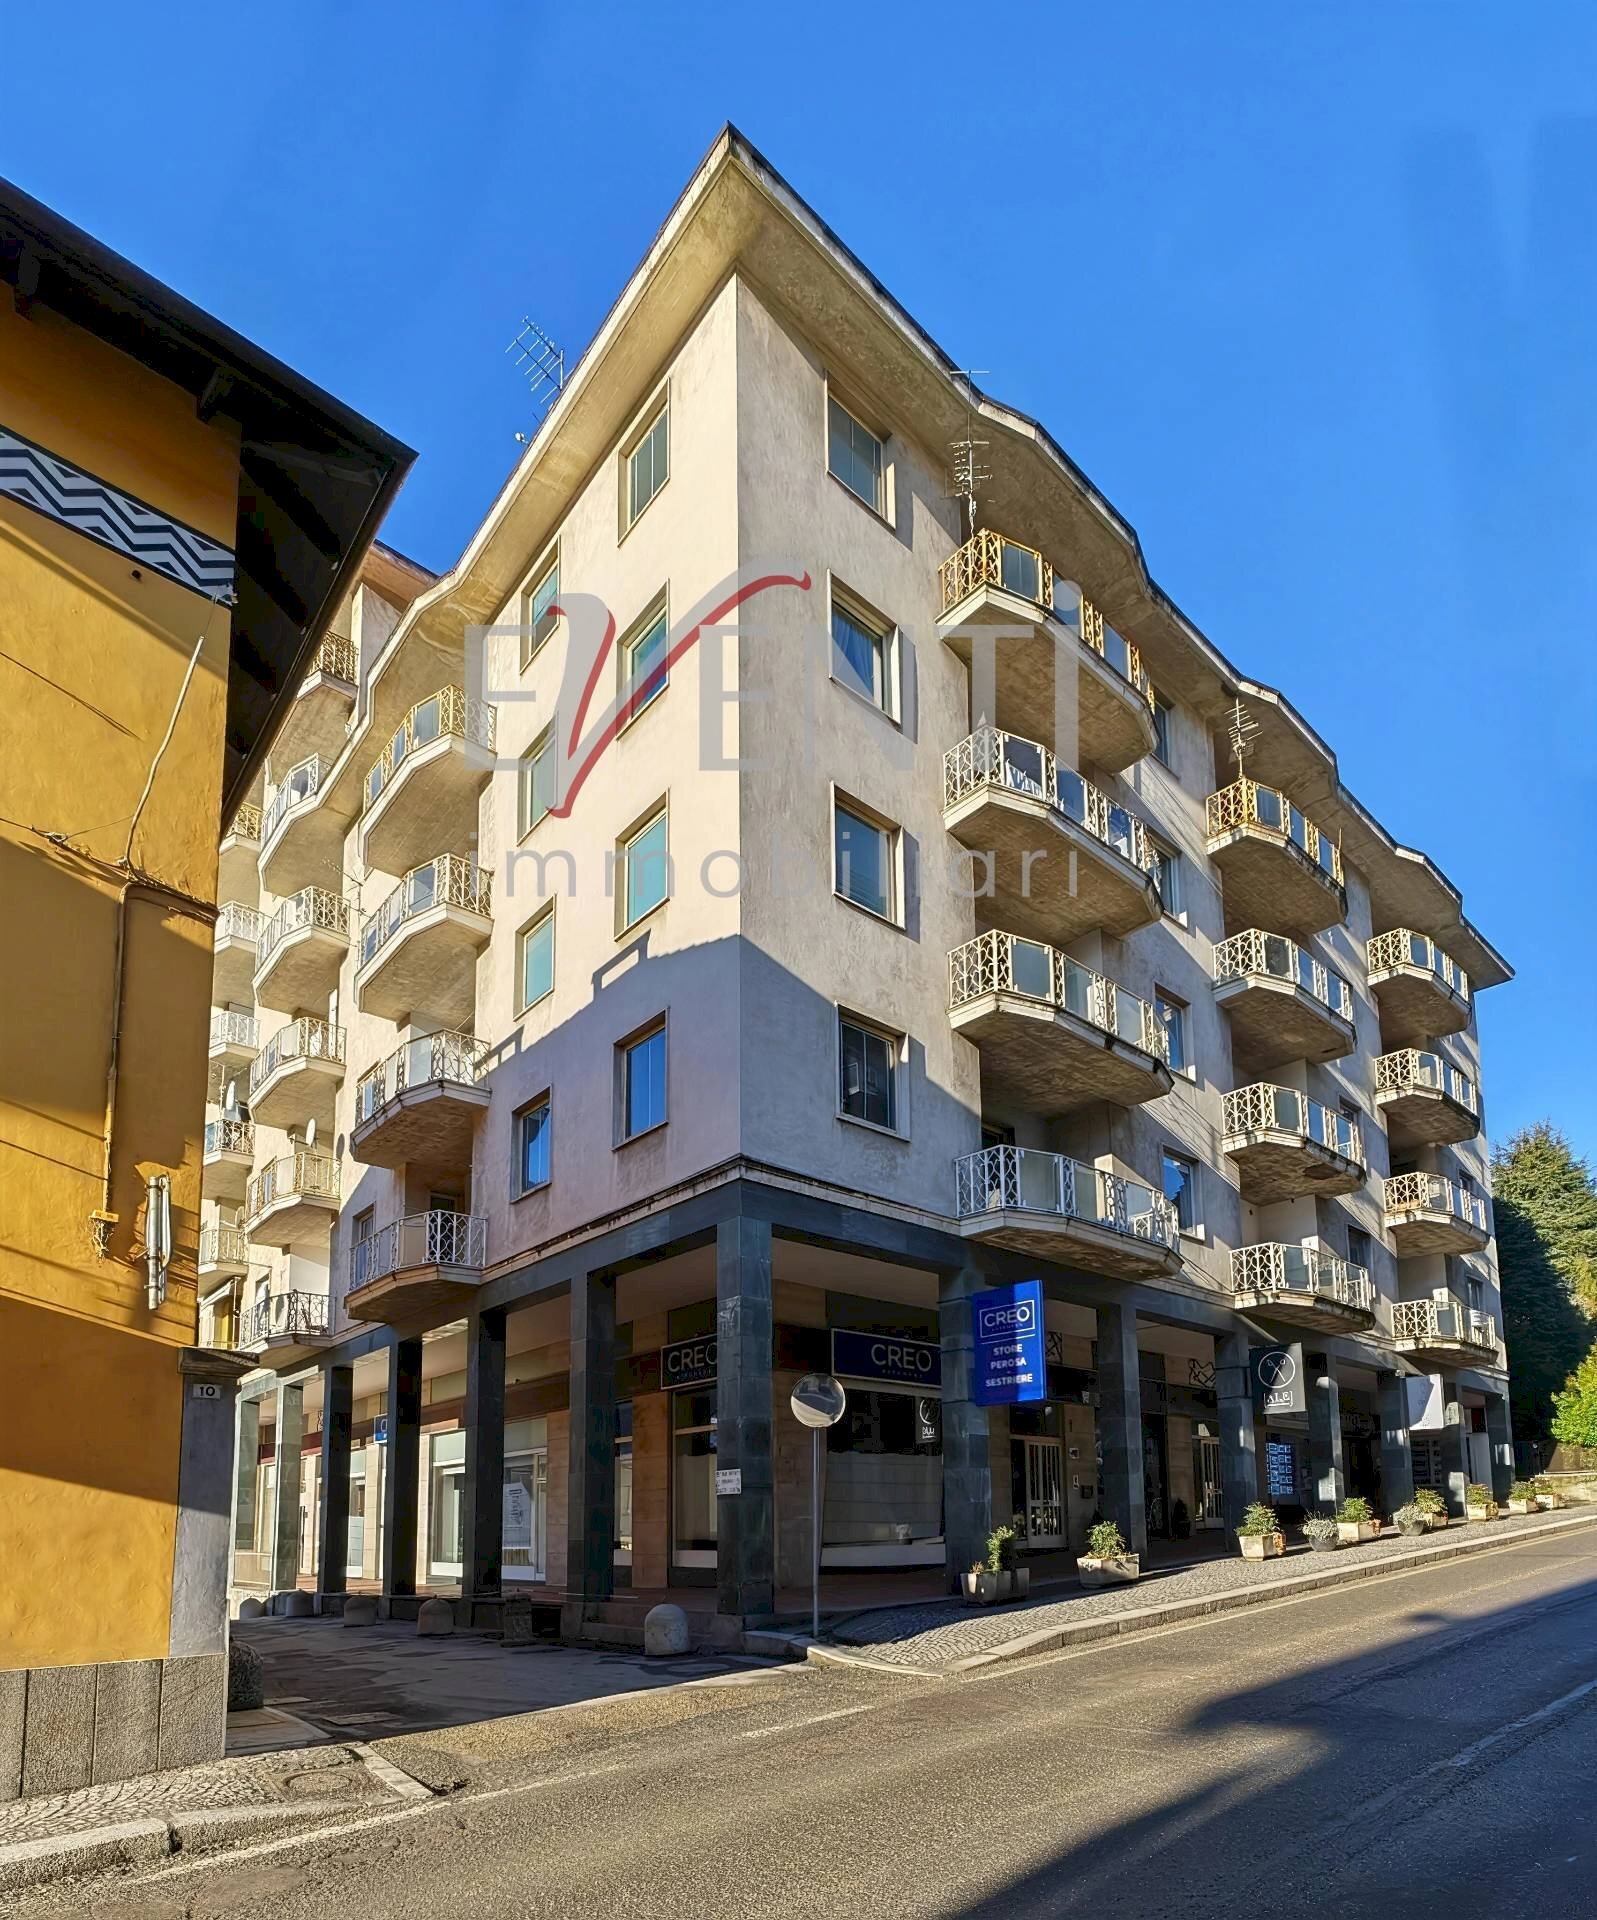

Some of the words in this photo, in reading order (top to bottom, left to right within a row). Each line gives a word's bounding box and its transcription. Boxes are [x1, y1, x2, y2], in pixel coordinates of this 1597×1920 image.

[983, 1306, 1030, 1327] CREO
[993, 1343, 1023, 1356] STORE
[871, 1344, 932, 1372] CREO
[990, 1357, 1027, 1370] PEROSA
[985, 1373, 1033, 1388] SESTRIERE
[200, 1386, 216, 1397] 10
